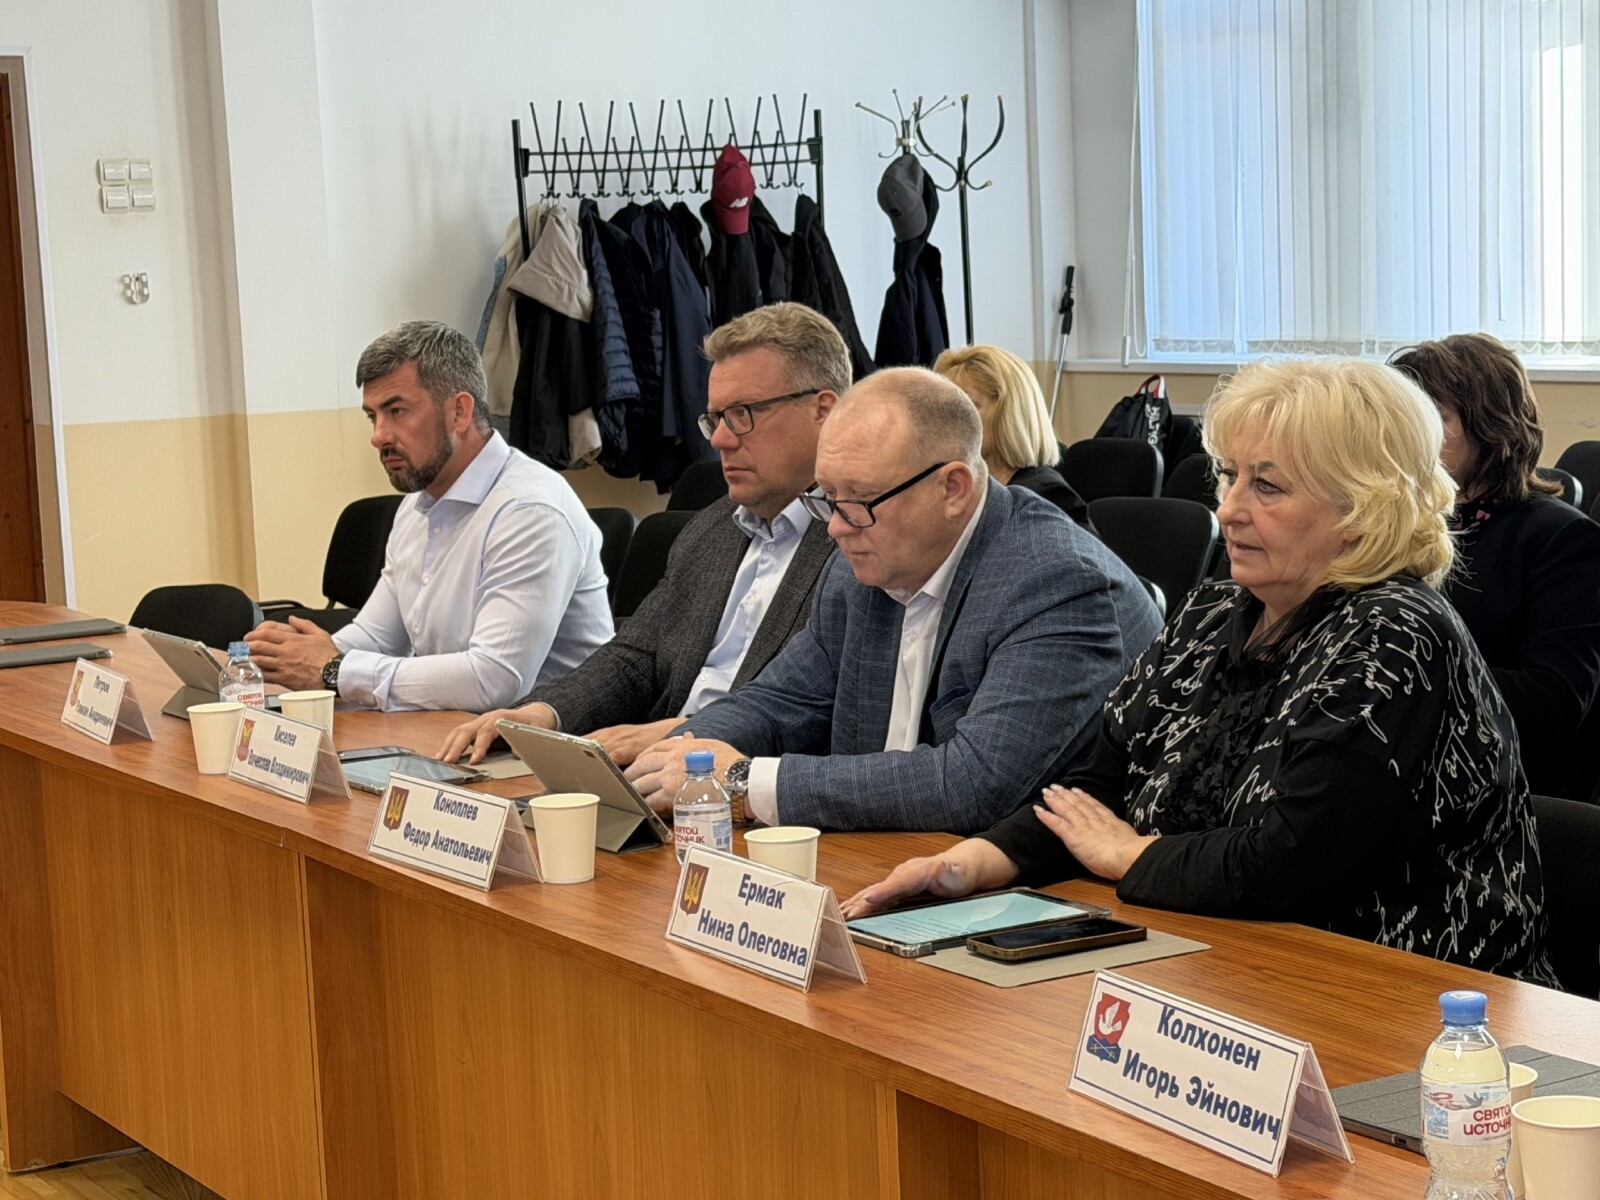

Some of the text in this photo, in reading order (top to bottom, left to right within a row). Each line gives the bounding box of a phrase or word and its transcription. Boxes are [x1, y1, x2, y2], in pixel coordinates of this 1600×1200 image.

[433, 790, 479, 821] Коноплев
[403, 821, 493, 865] Федор Анатольевич
[738, 873, 786, 909] Ермак
[697, 908, 808, 967] Нина Олеговна
[1156, 1005, 1261, 1071] Колхонен
[1122, 1049, 1281, 1140] Игорь Эйнович
[1473, 1104, 1511, 1122] СВЯТО
